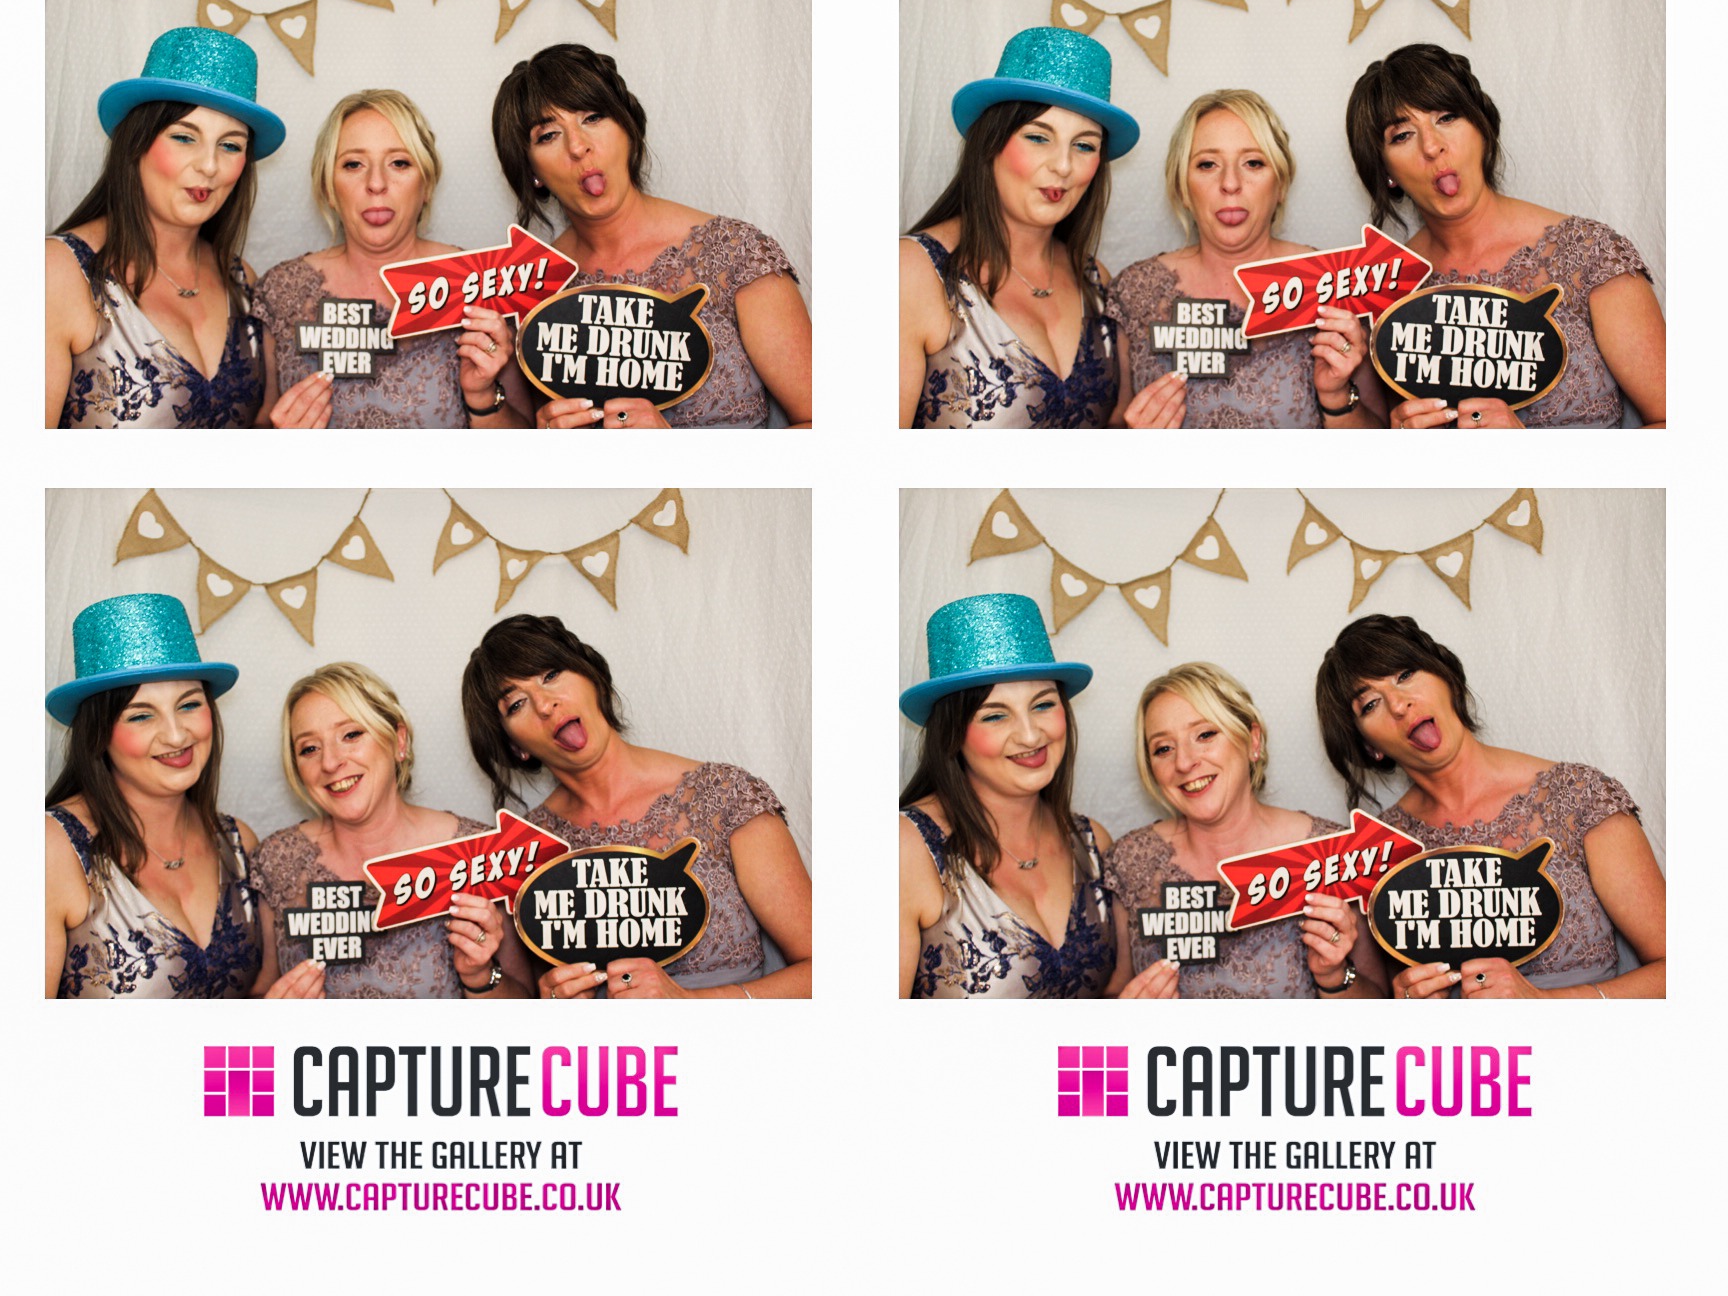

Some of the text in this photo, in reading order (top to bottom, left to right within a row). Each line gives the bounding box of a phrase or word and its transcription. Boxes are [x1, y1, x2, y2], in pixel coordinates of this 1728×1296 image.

[408, 258, 548, 314] SO SEXY!
[1262, 258, 1402, 314] SO SEXY!
[323, 302, 372, 325] BEST
[578, 294, 654, 328] TAKE
[1177, 302, 1226, 325] BEST
[1432, 294, 1508, 328] TAKE
[536, 321, 692, 362] ME DRUNK
[1390, 321, 1546, 362] ME DRUNK
[323, 351, 371, 374] EVER
[541, 352, 683, 393] I'M HOME
[1177, 351, 1225, 374] EVER
[1395, 352, 1537, 393] I'M HOME
[393, 841, 540, 905] SO SEXY!
[571, 857, 650, 889] TAKE
[1247, 841, 1394, 905] SO SEXY!
[1425, 857, 1504, 889] TAKE
[312, 886, 362, 910] BEST
[534, 886, 688, 921] ME DRUNK
[1166, 886, 1216, 910] BEST
[1388, 886, 1542, 921] ME DRUNK
[288, 910, 377, 936] WEDDIN
[540, 917, 682, 950] I'M HOME
[1142, 910, 1231, 936] WEDDIN
[1394, 917, 1536, 950] I'M HOME
[313, 936, 362, 960] EVER
[1167, 936, 1216, 960] EVER
